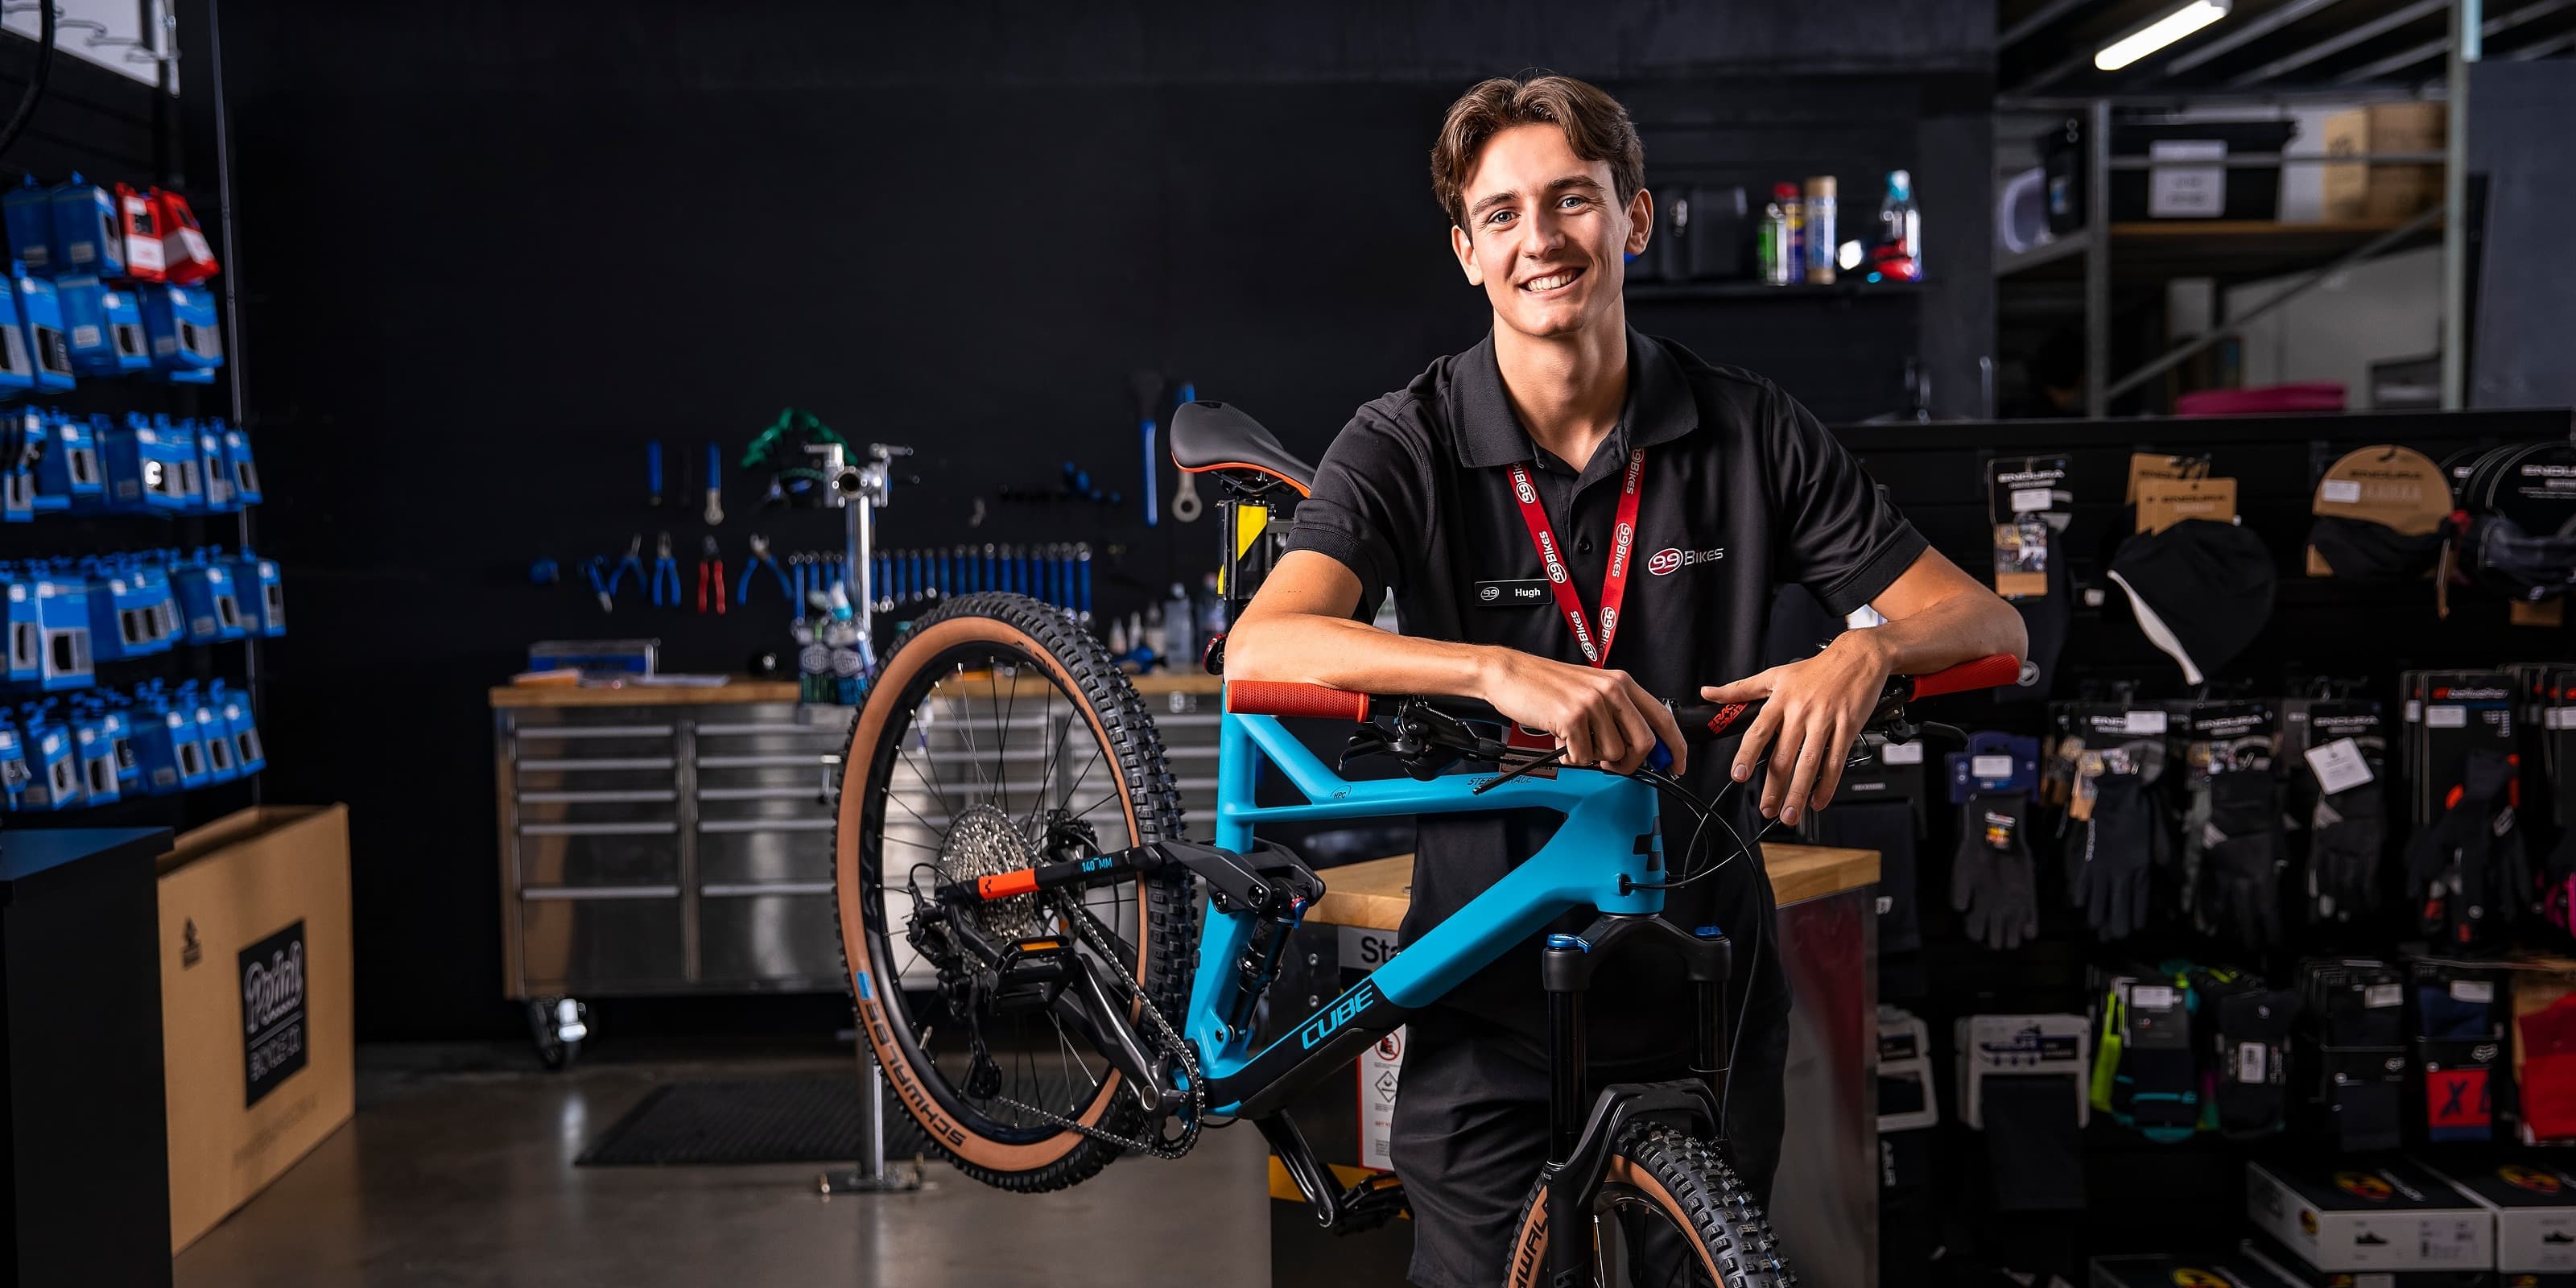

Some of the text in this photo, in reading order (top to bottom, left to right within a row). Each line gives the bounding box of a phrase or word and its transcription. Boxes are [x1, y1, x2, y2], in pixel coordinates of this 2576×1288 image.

[1515, 588, 1541, 598] Hugh
[1302, 985, 1373, 1050] CUBE
[865, 1002, 966, 1147] SCHWALBE
